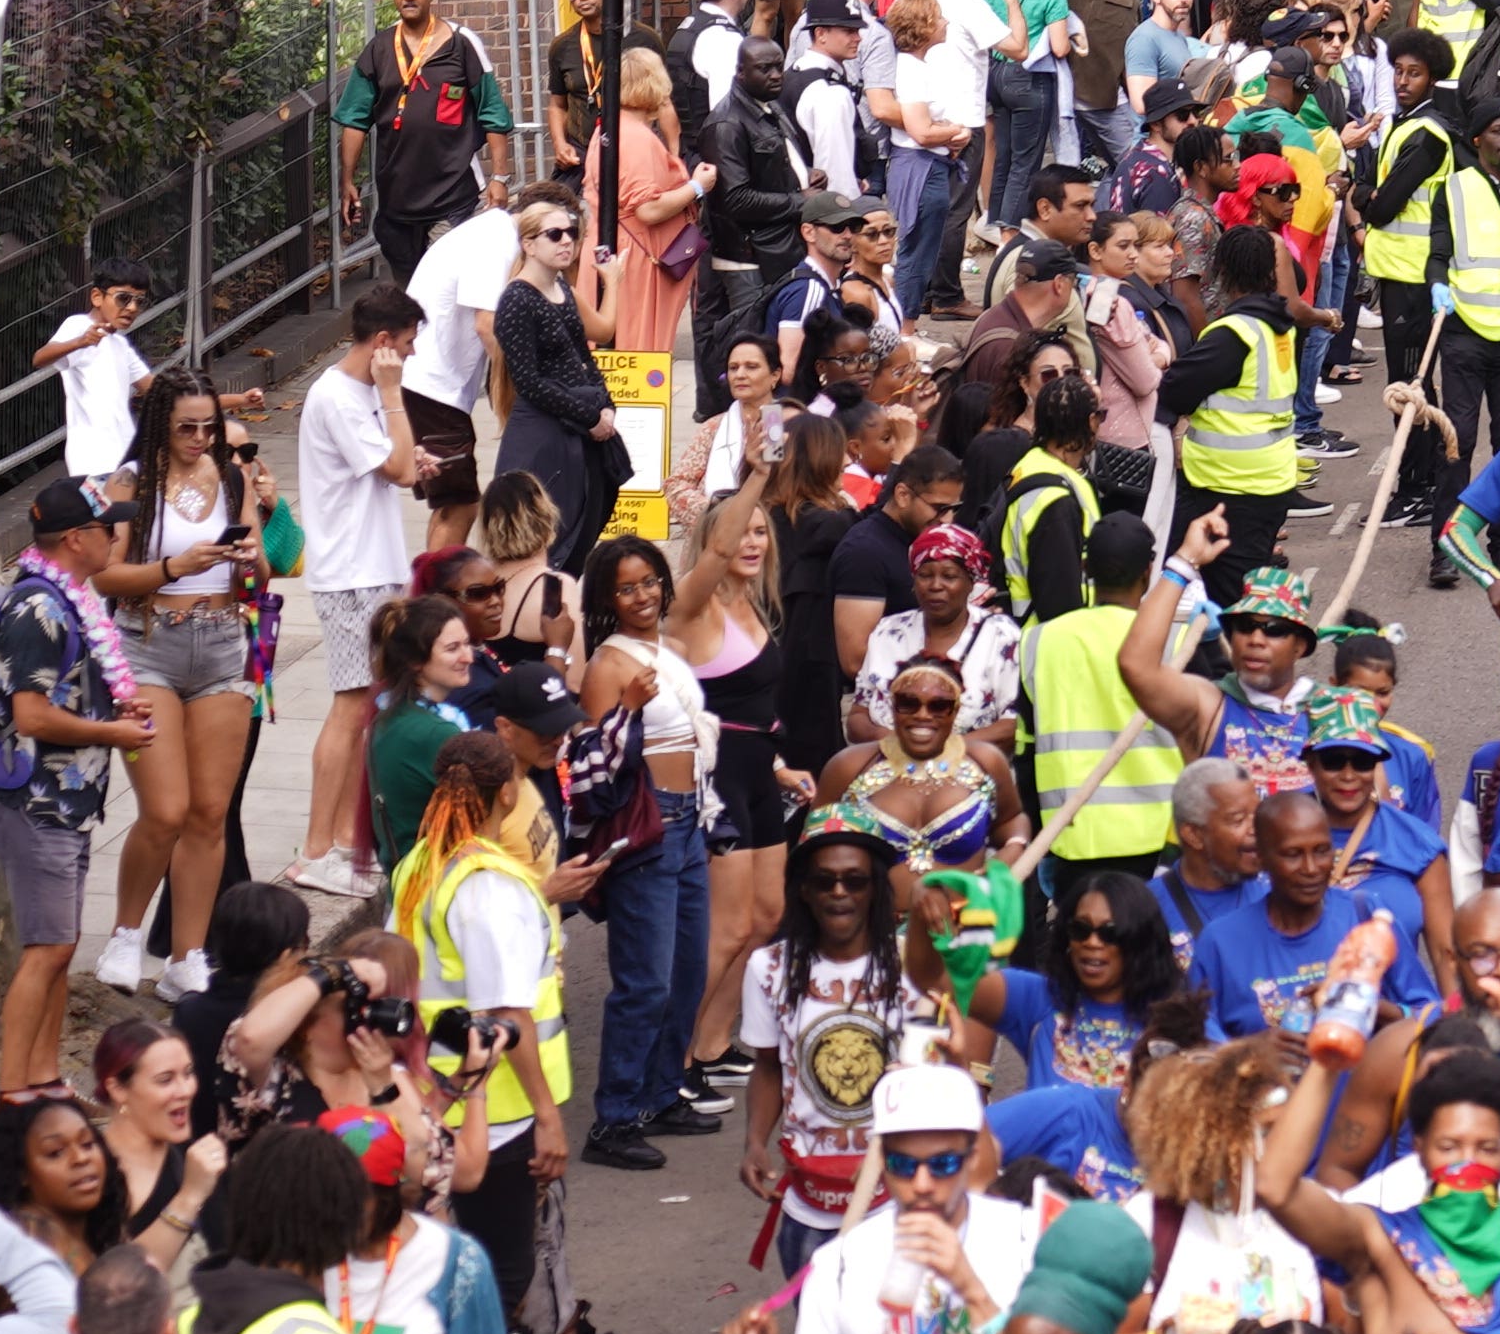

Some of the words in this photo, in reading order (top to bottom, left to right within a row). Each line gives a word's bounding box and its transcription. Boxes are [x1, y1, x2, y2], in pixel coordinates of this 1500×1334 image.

[603, 373, 628, 386] king
[611, 510, 638, 522] ting
[603, 524, 638, 535] ading
